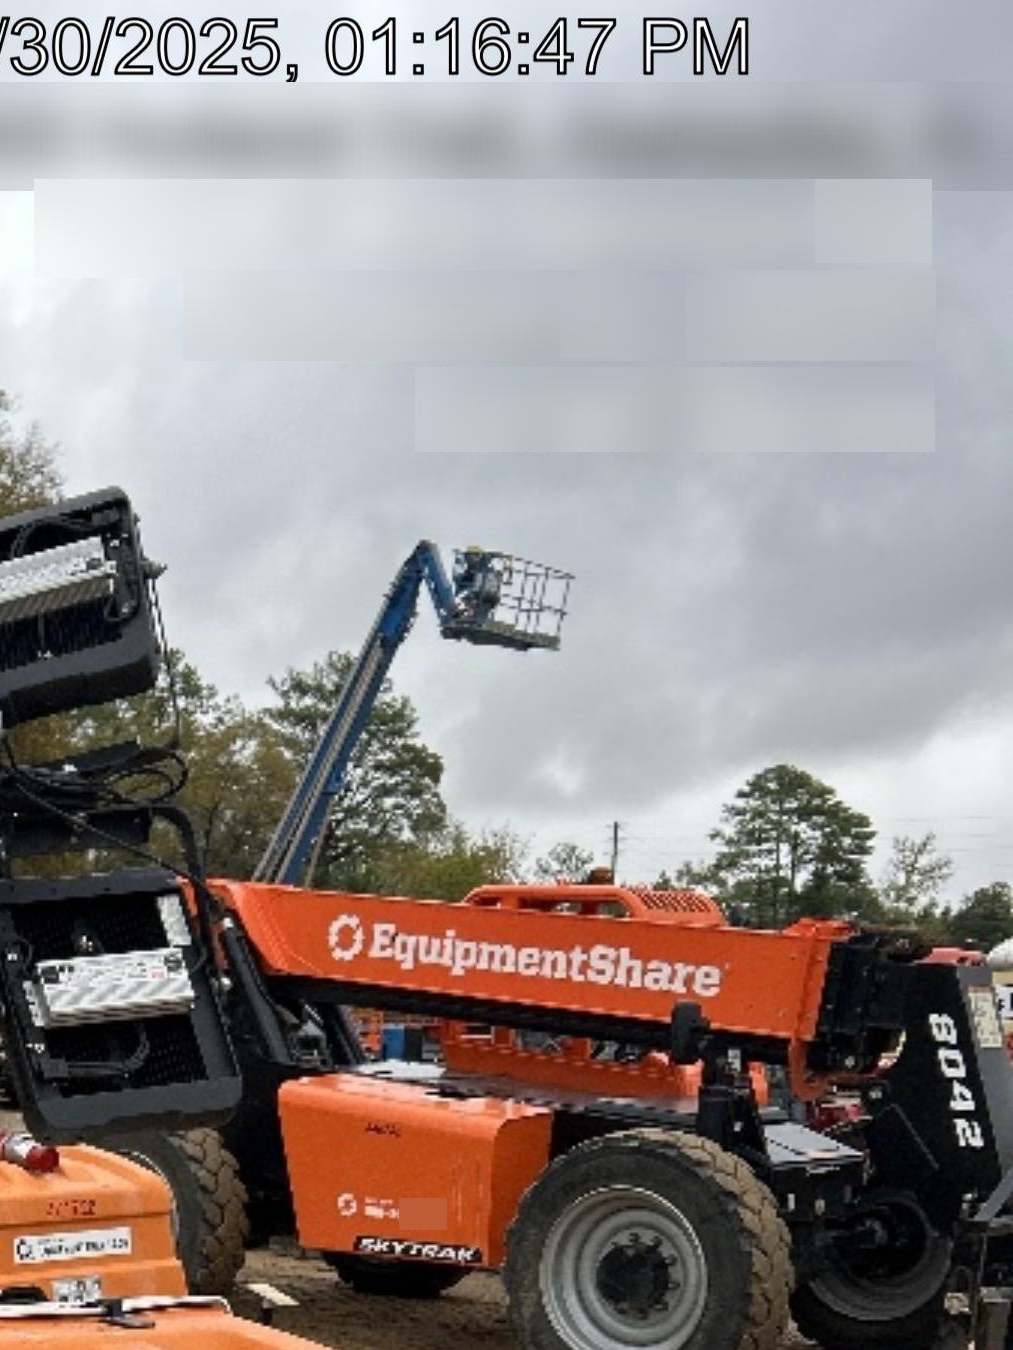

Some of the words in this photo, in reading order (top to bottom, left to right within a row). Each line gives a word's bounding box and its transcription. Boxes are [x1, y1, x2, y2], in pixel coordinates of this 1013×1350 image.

[368, 922, 722, 997] EquipmentShare
[928, 1012, 985, 1148] 8042
[359, 1237, 477, 1262] SKYTRAK
